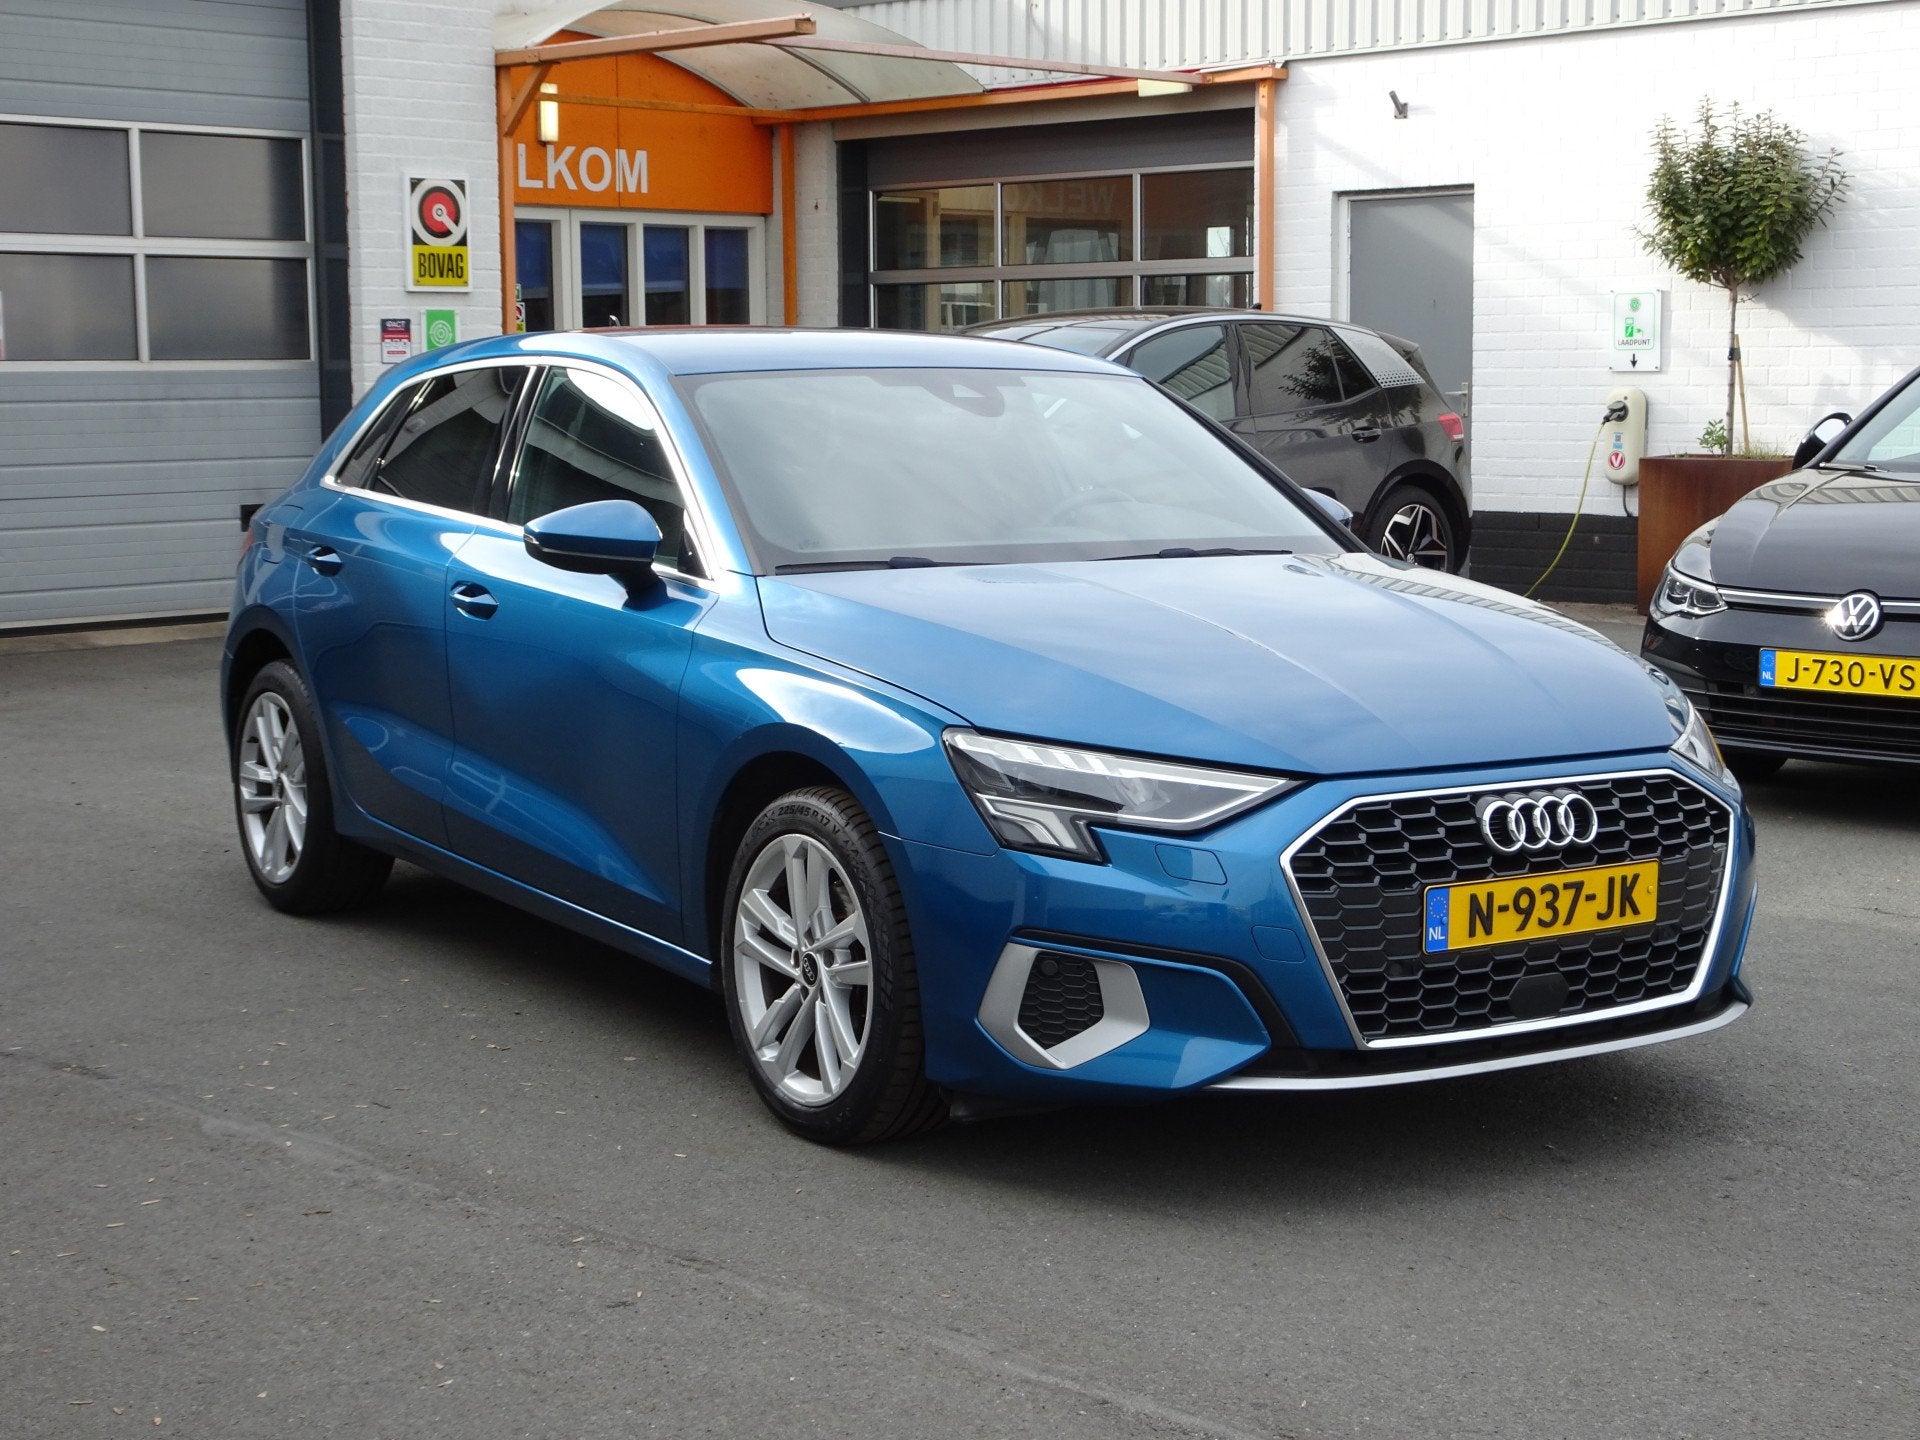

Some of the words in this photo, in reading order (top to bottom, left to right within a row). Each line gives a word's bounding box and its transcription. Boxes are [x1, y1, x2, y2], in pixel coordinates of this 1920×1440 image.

[418, 252, 464, 279] BOVAG
[1762, 671, 1774, 680] NL
[1787, 657, 1916, 691] J-730-VS
[778, 804, 811, 817] 225/45
[820, 814, 831, 827] 17
[1468, 873, 1641, 939] N-937-JK
[1429, 927, 1445, 941] NL
